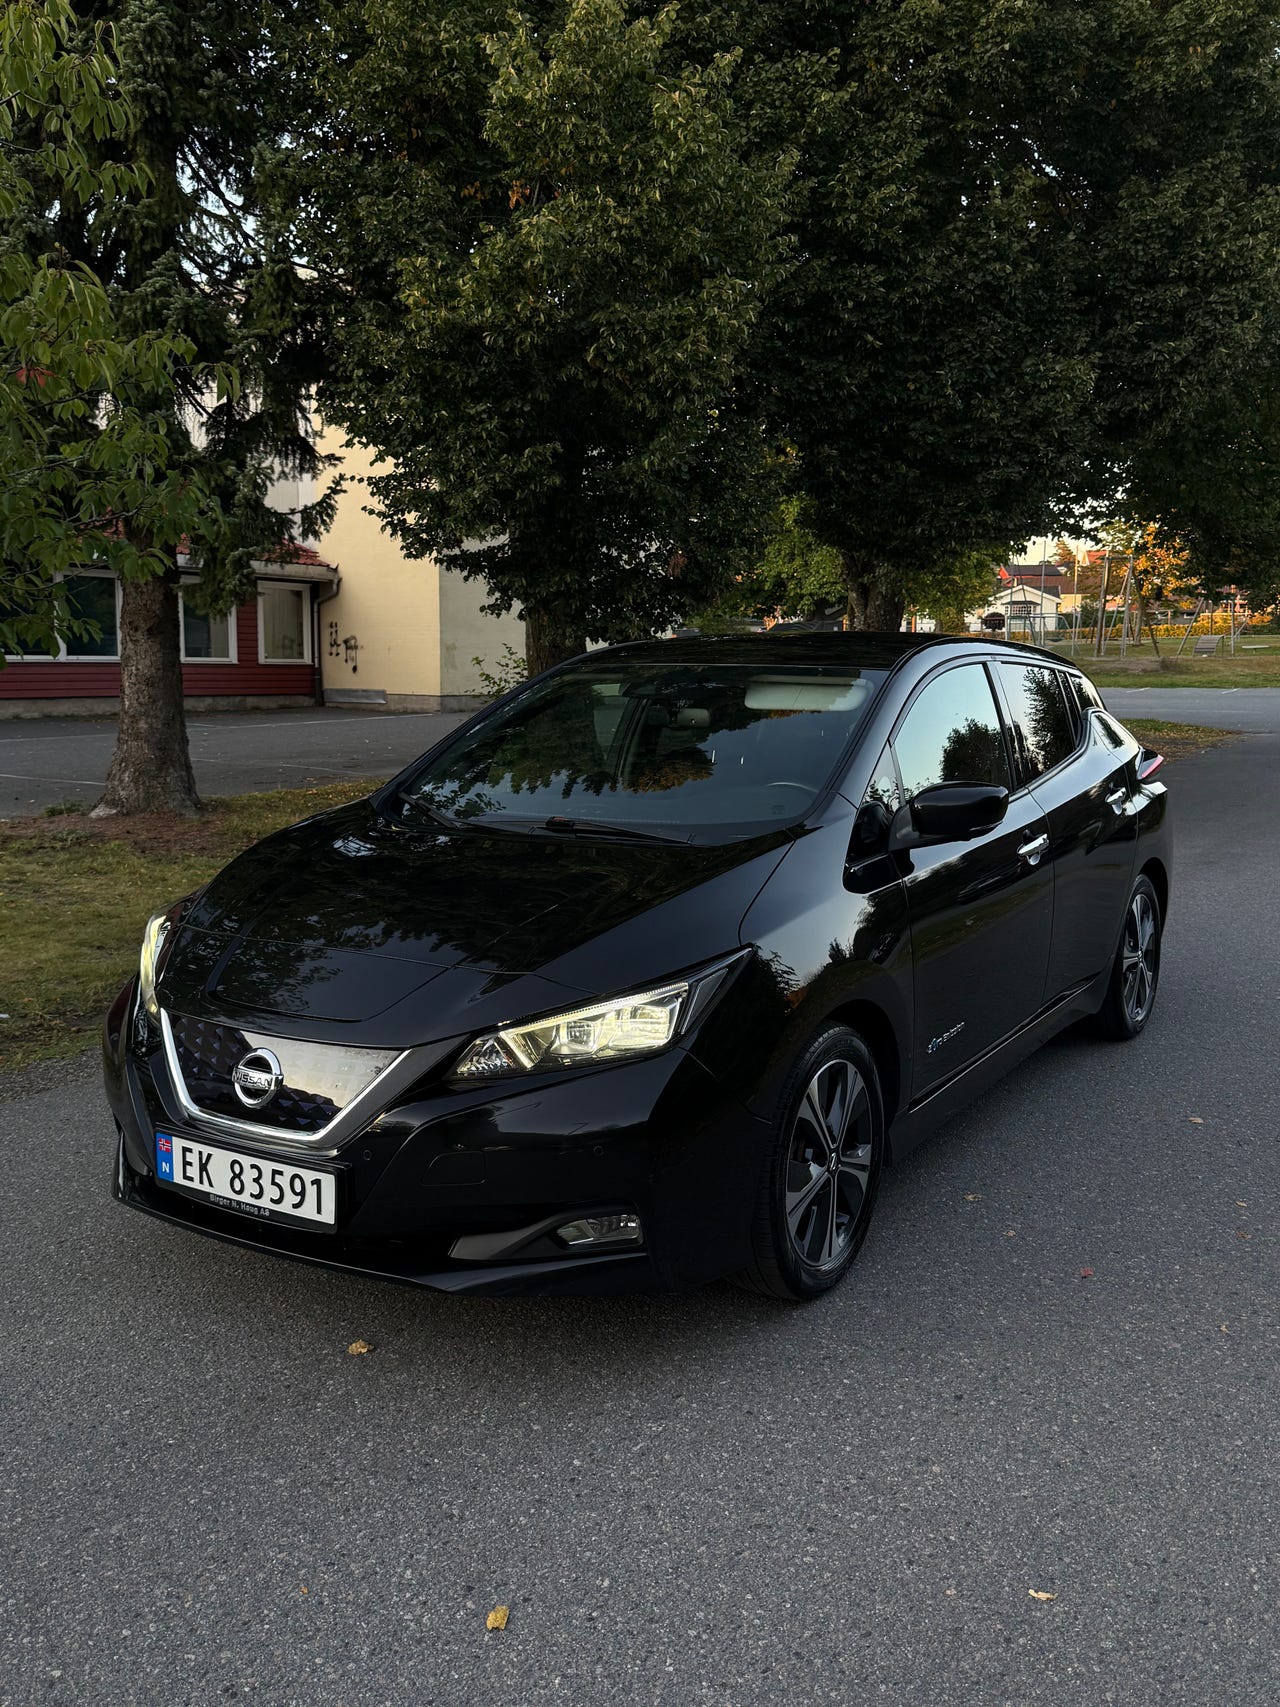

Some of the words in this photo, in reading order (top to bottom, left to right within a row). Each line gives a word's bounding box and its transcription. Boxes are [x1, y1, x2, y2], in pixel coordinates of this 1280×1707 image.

[233, 1069, 272, 1088] NISSAN
[162, 1161, 170, 1174] N
[181, 1146, 215, 1188] EK
[229, 1159, 322, 1215] 83591
